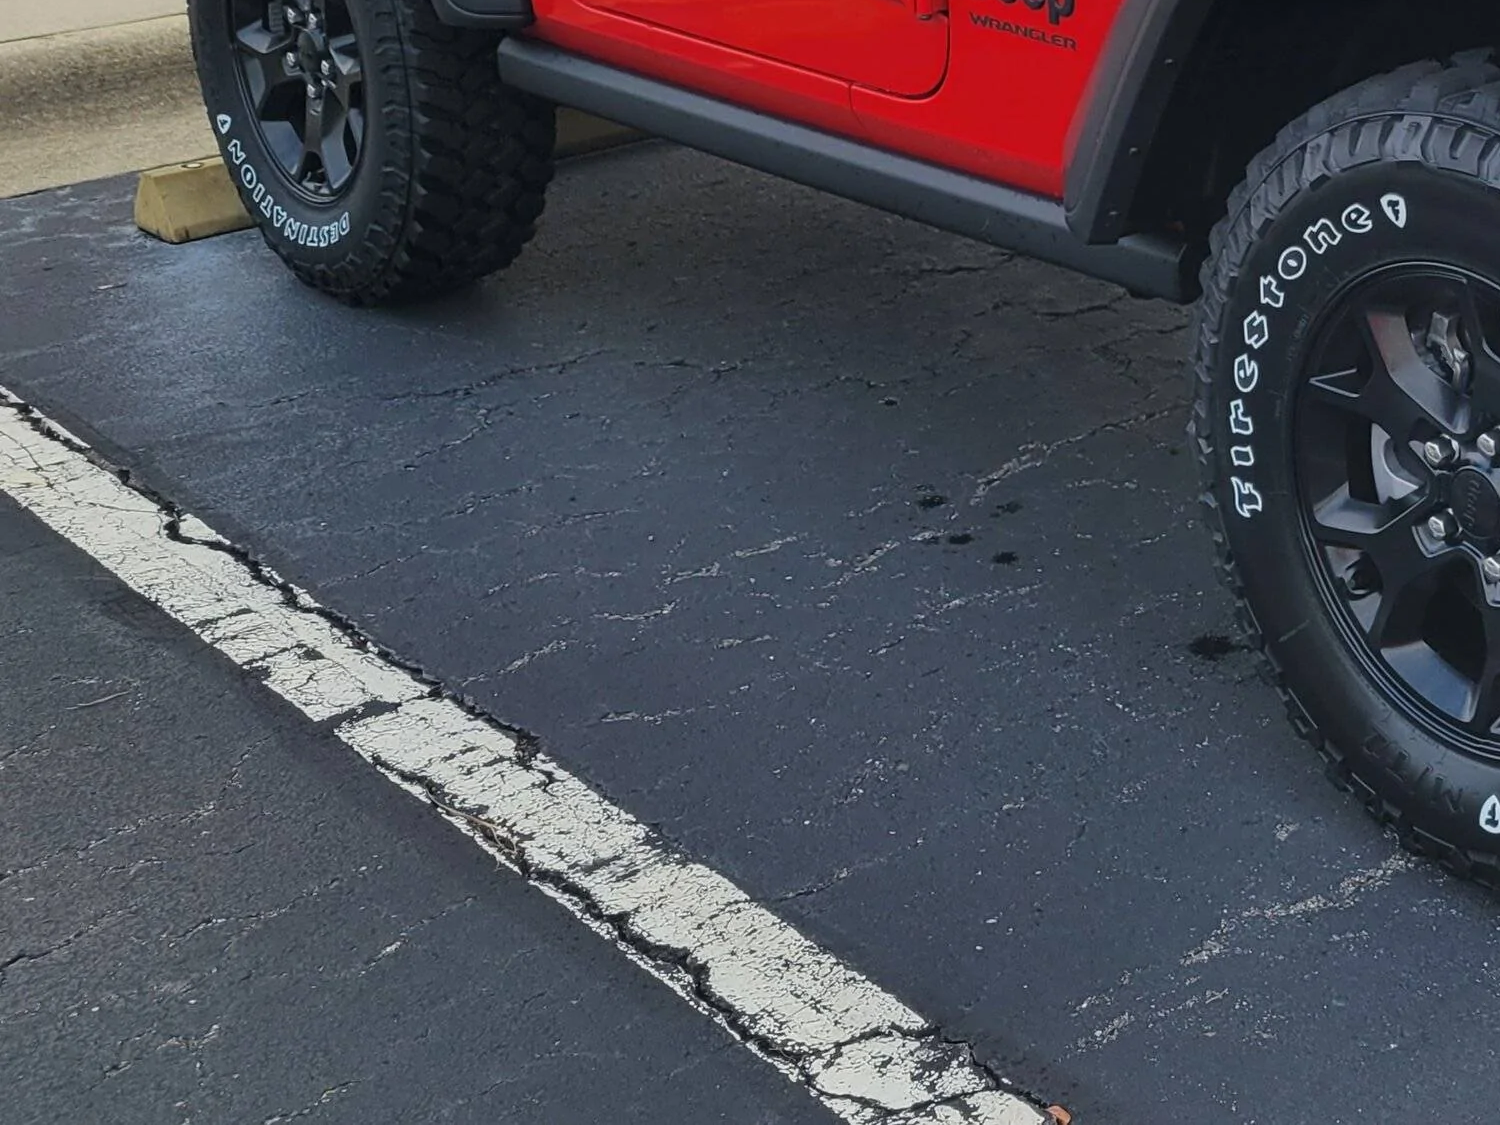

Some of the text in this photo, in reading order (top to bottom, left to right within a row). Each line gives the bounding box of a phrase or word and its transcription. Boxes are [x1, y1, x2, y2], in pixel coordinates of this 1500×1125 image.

[969, 11, 1077, 51] WRANGLER
[228, 139, 350, 247] DESTINATION
[1230, 203, 1373, 518] Firestone
